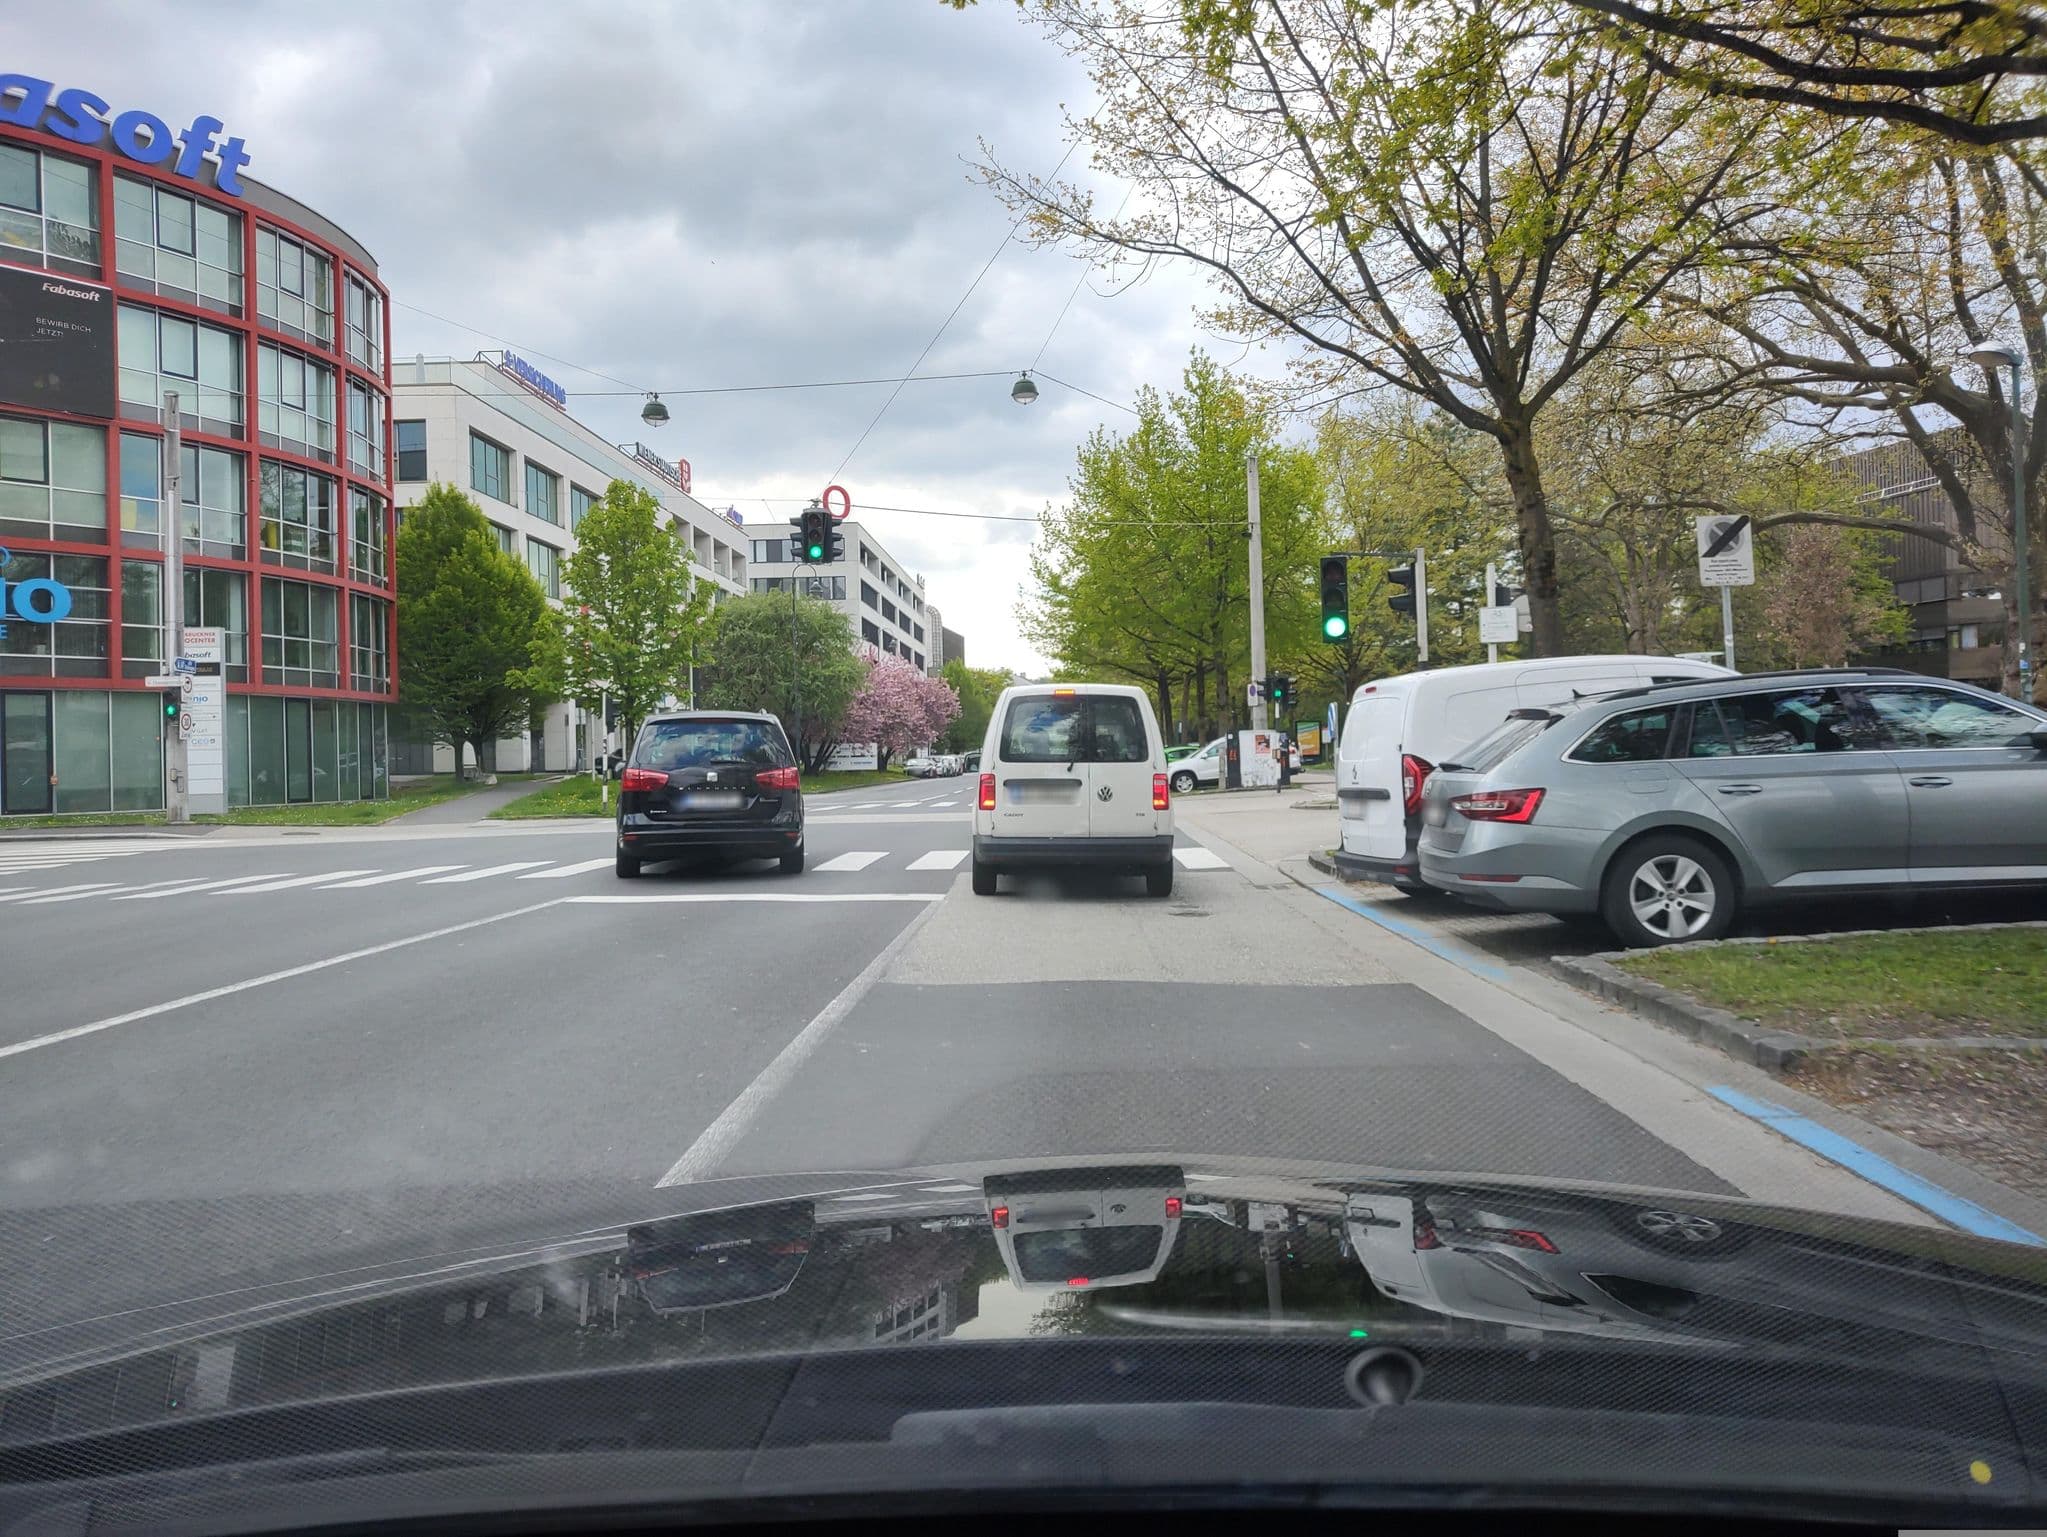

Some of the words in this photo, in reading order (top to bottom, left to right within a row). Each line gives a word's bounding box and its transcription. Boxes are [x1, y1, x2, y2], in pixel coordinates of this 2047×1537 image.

[0, 73, 251, 198] asoft
[42, 282, 100, 302] Fabasoft
[36, 317, 70, 329] BEWIRB
[71, 323, 91, 333] DICH
